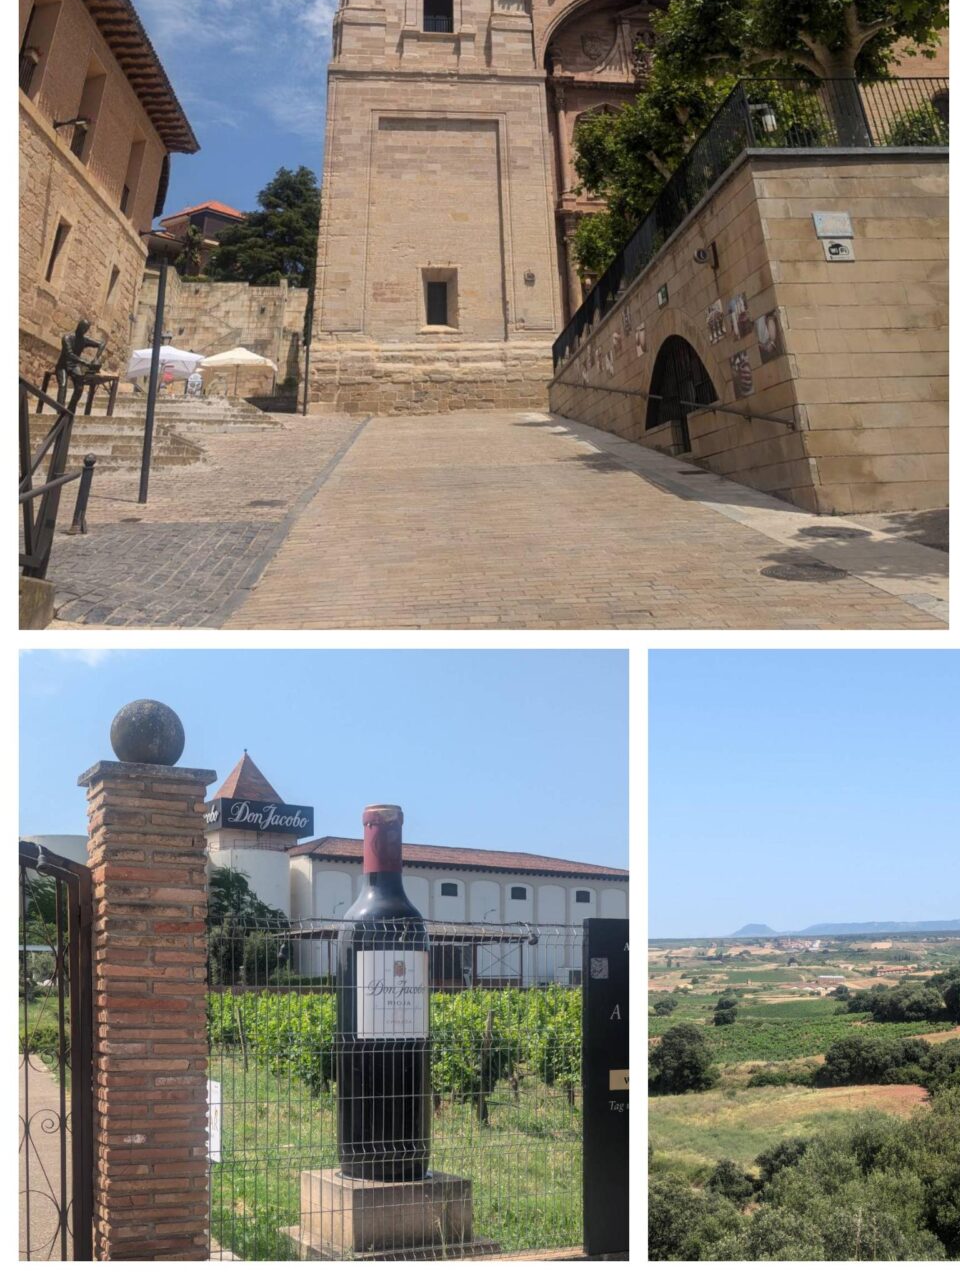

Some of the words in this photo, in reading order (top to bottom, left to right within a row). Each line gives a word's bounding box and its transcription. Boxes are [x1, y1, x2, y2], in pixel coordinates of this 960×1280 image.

[228, 801, 262, 824] Don
[259, 804, 308, 830] Jacobo
[609, 1100, 624, 1113] Tag
